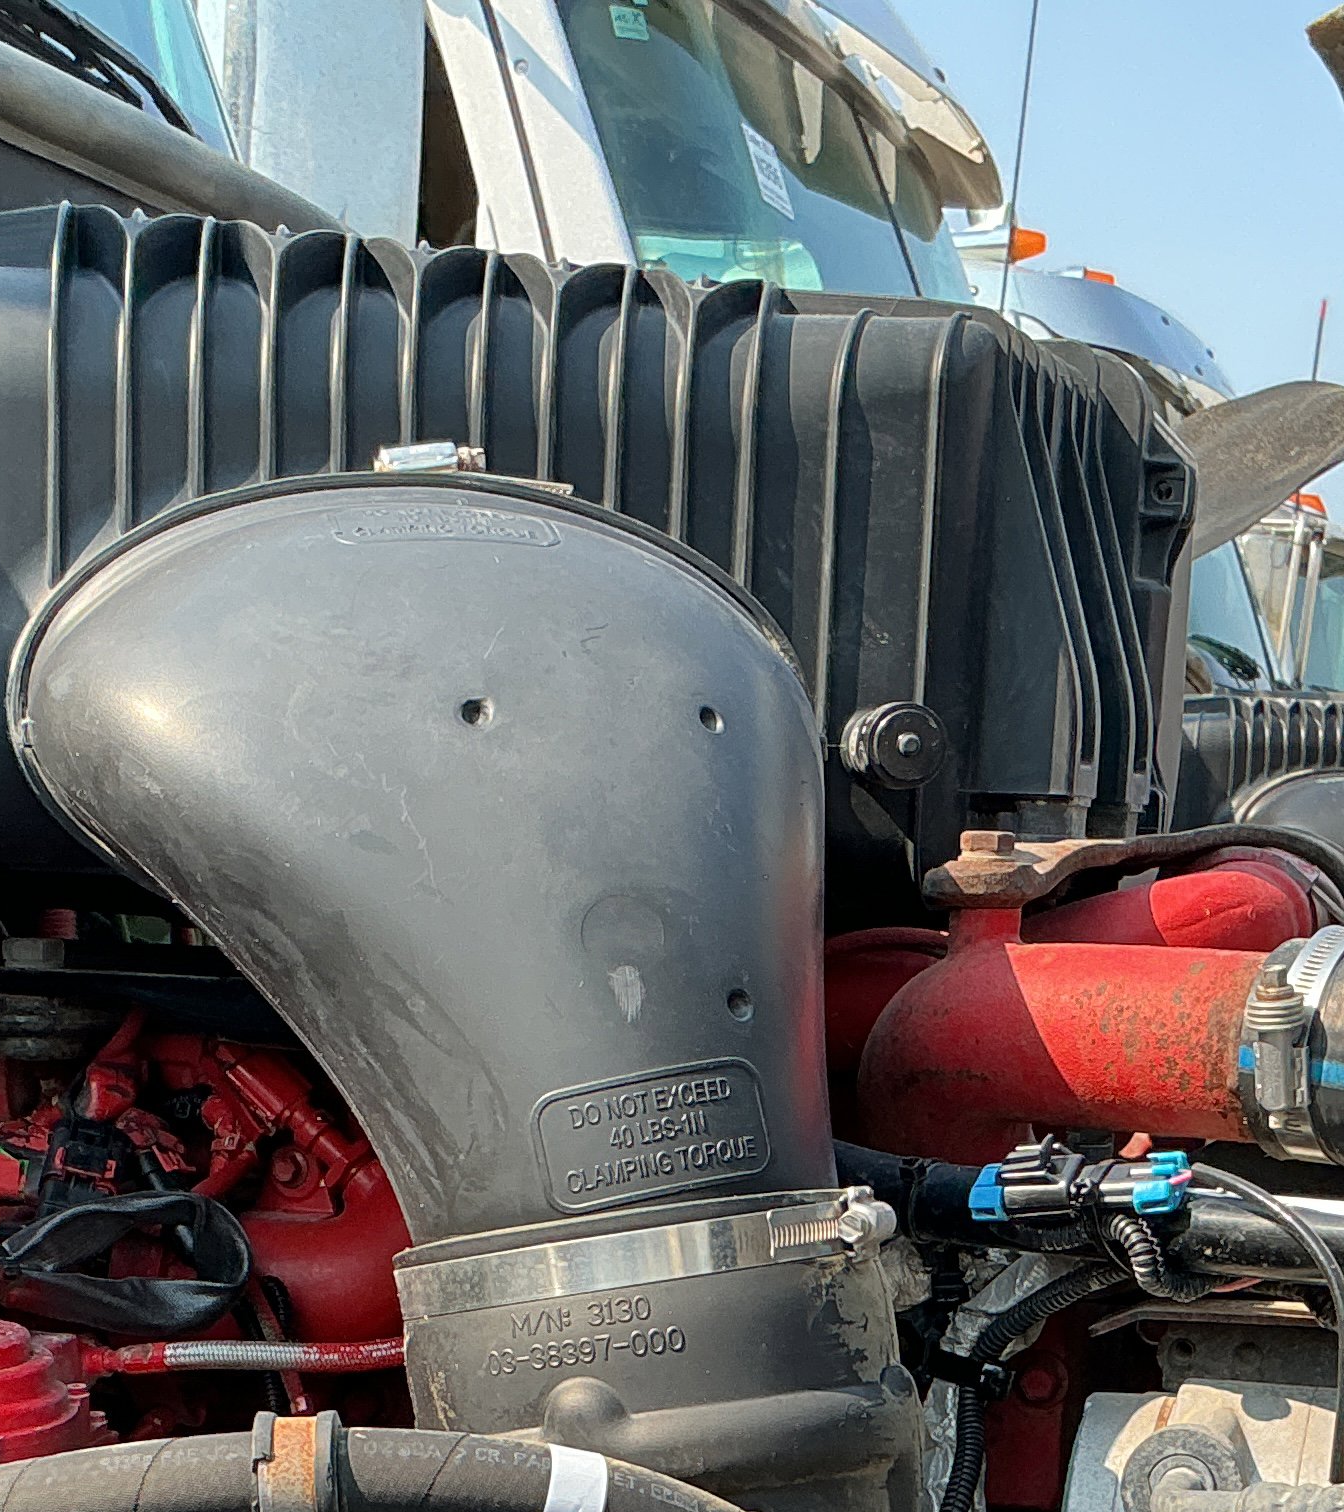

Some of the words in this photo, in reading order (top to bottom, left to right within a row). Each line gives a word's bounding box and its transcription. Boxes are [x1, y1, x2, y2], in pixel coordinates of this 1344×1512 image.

[567, 1100, 601, 1130] DO
[604, 1089, 649, 1121] NOT
[650, 1075, 733, 1113] EXCEED
[608, 1123, 635, 1150] 40
[566, 1148, 674, 1194] CLAMPING
[673, 1135, 758, 1172] TORQUE
[510, 1305, 572, 1339] M/N:
[586, 1294, 652, 1327] 3130
[488, 1324, 687, 1376] 03-38397-000
